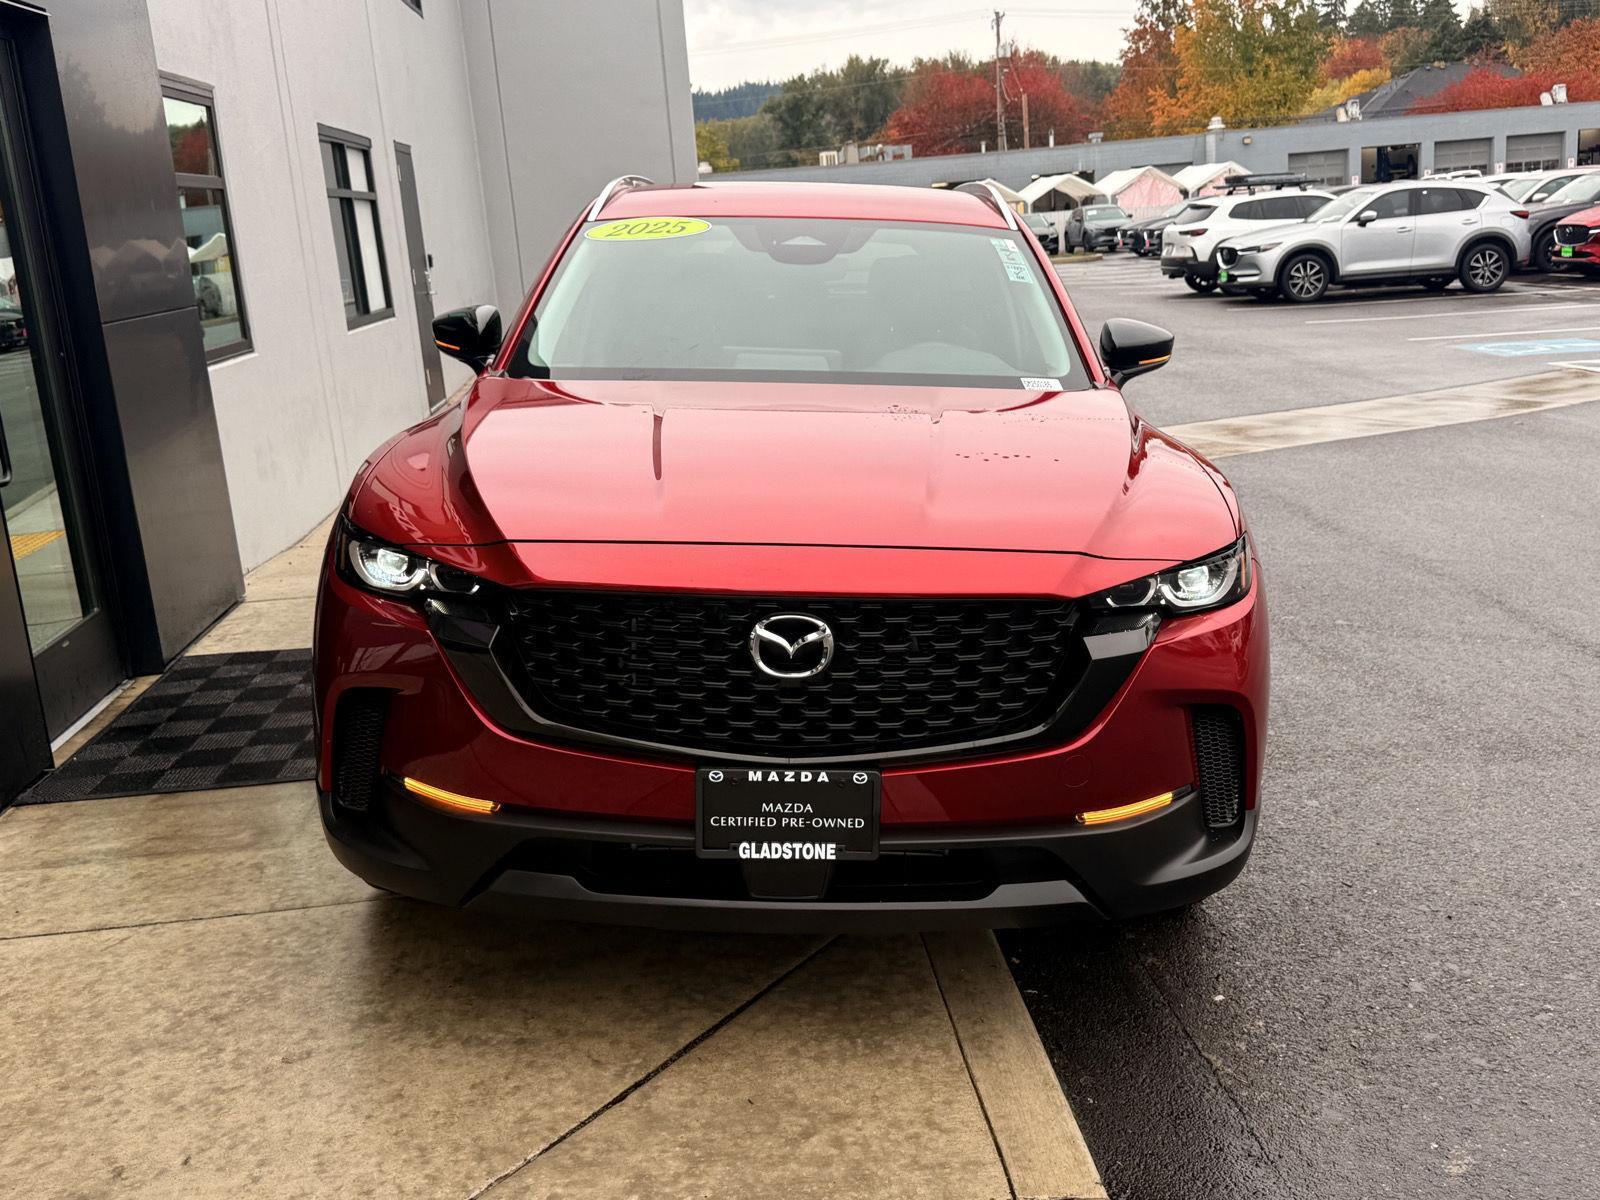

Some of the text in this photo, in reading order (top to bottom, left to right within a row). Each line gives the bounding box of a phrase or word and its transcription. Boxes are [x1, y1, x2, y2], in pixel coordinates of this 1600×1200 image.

[605, 221, 691, 238] 2025
[748, 770, 829, 782] MAZDA
[761, 803, 814, 813] MAZDA
[710, 816, 865, 829] CERTIFIED PRE-OWNED
[738, 842, 837, 860] GLADSTONE
